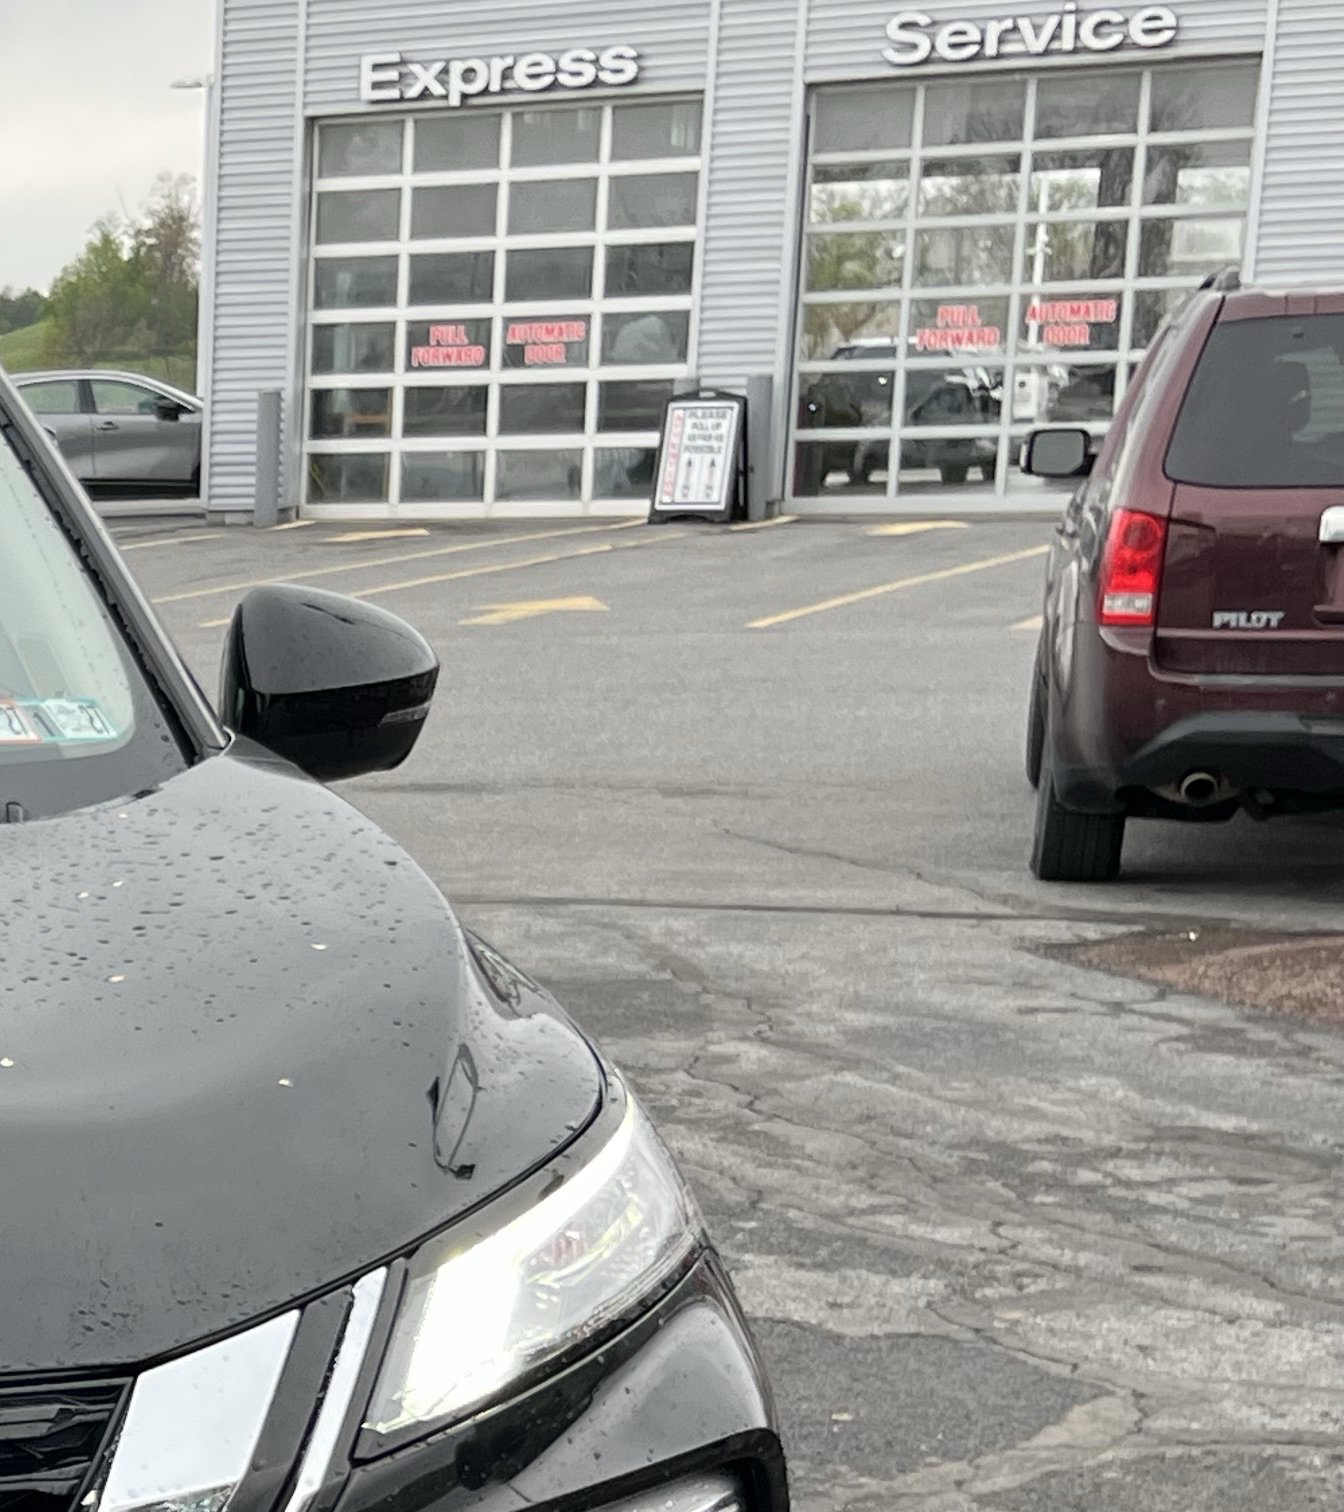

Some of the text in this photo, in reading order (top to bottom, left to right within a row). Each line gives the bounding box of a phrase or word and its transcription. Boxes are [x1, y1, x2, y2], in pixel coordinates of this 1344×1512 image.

[358, 3, 1180, 106] Express Service
[937, 305, 981, 326] PULL
[1026, 300, 1116, 323] AUTOMATIC
[430, 325, 469, 345] PULL
[506, 322, 586, 343] AUTOMATIC
[916, 327, 1000, 350] FORWARD
[1044, 324, 1089, 345] DOOR
[412, 346, 485, 366] FORWARD
[525, 344, 566, 363] DOOR
[1213, 611, 1284, 628] PILOT
